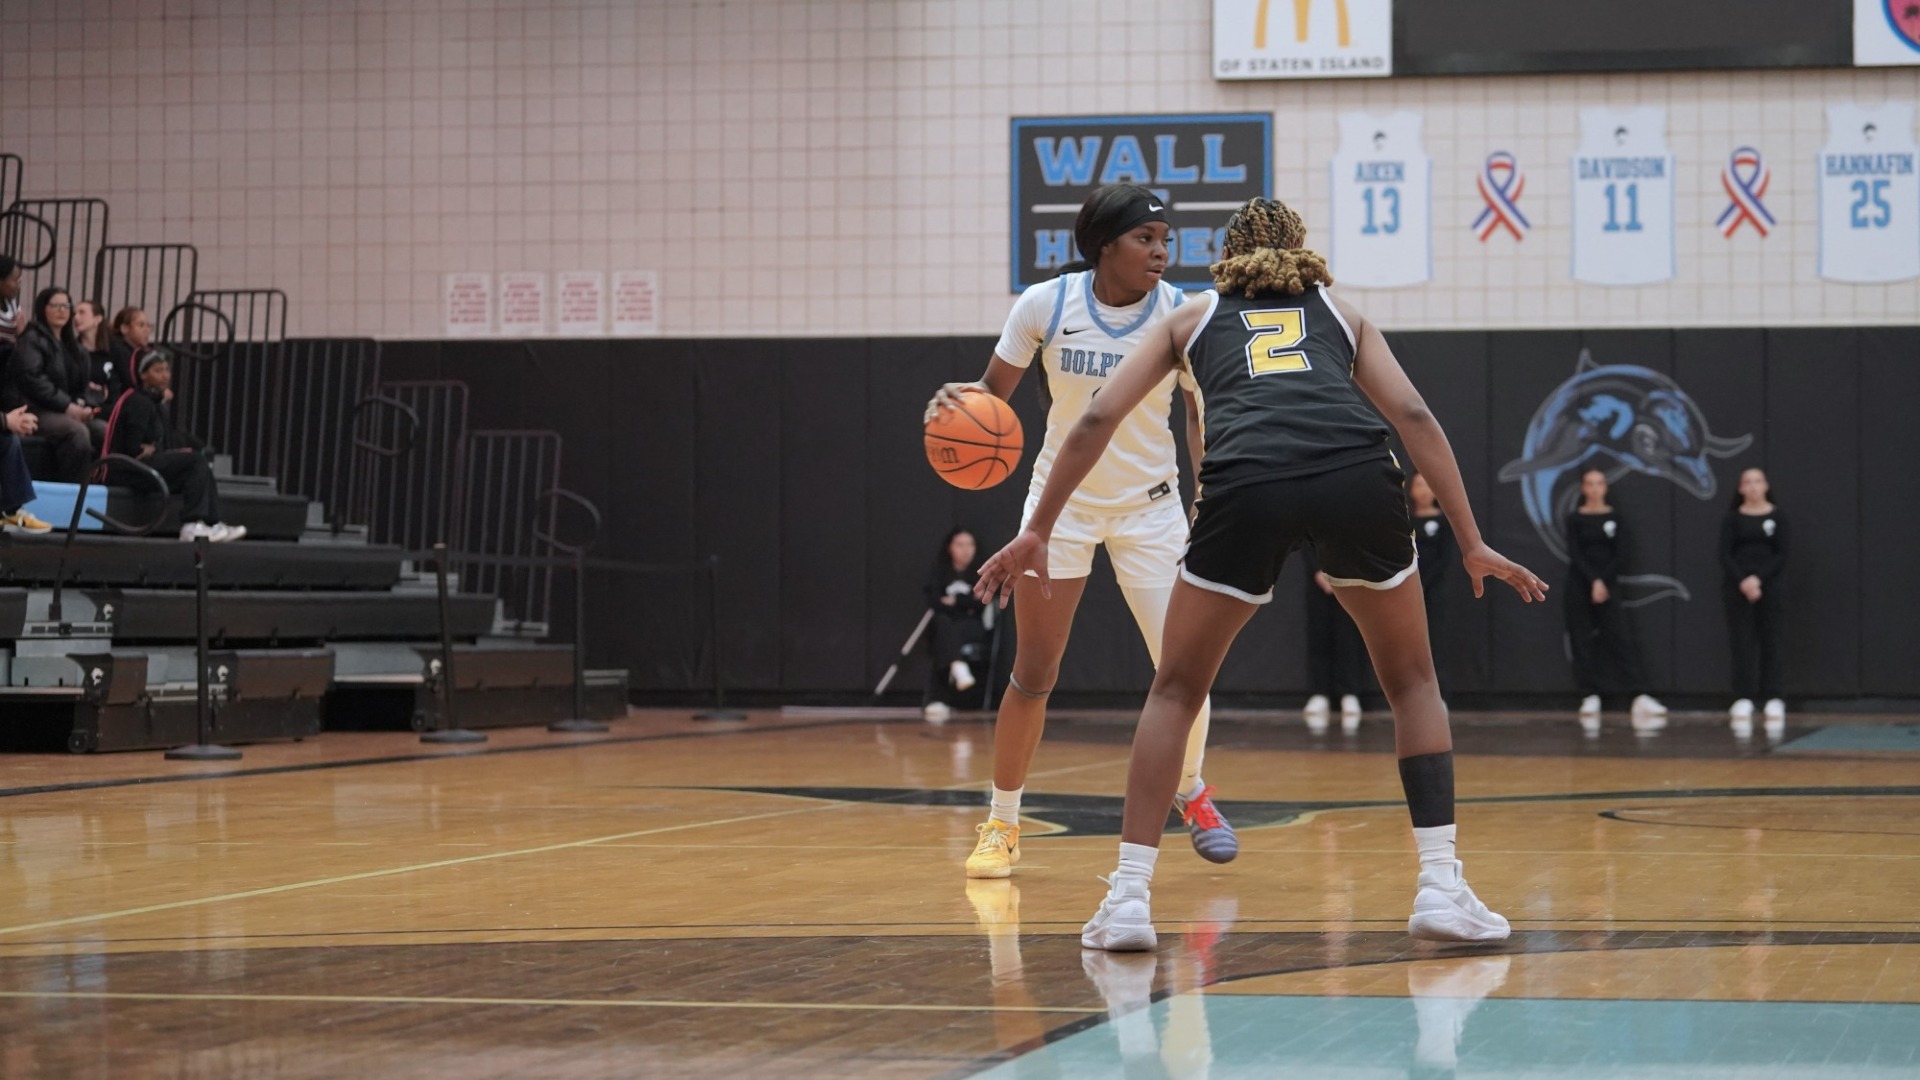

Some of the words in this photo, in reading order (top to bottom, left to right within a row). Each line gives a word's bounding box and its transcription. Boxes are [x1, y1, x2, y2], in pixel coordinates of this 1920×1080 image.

[1219, 59, 1241, 72] OF
[1248, 58, 1313, 71] STATEN
[1320, 56, 1385, 70] ISLAND
[1033, 133, 1247, 186] WALL
[1354, 161, 1405, 183] AIKEN
[1579, 157, 1665, 179] DAVIDSON
[1826, 153, 1914, 177] HANNAFIN
[1361, 186, 1400, 235] 13
[1603, 182, 1642, 232] 11
[1851, 179, 1891, 229] 25
[1239, 307, 1312, 379] 2
